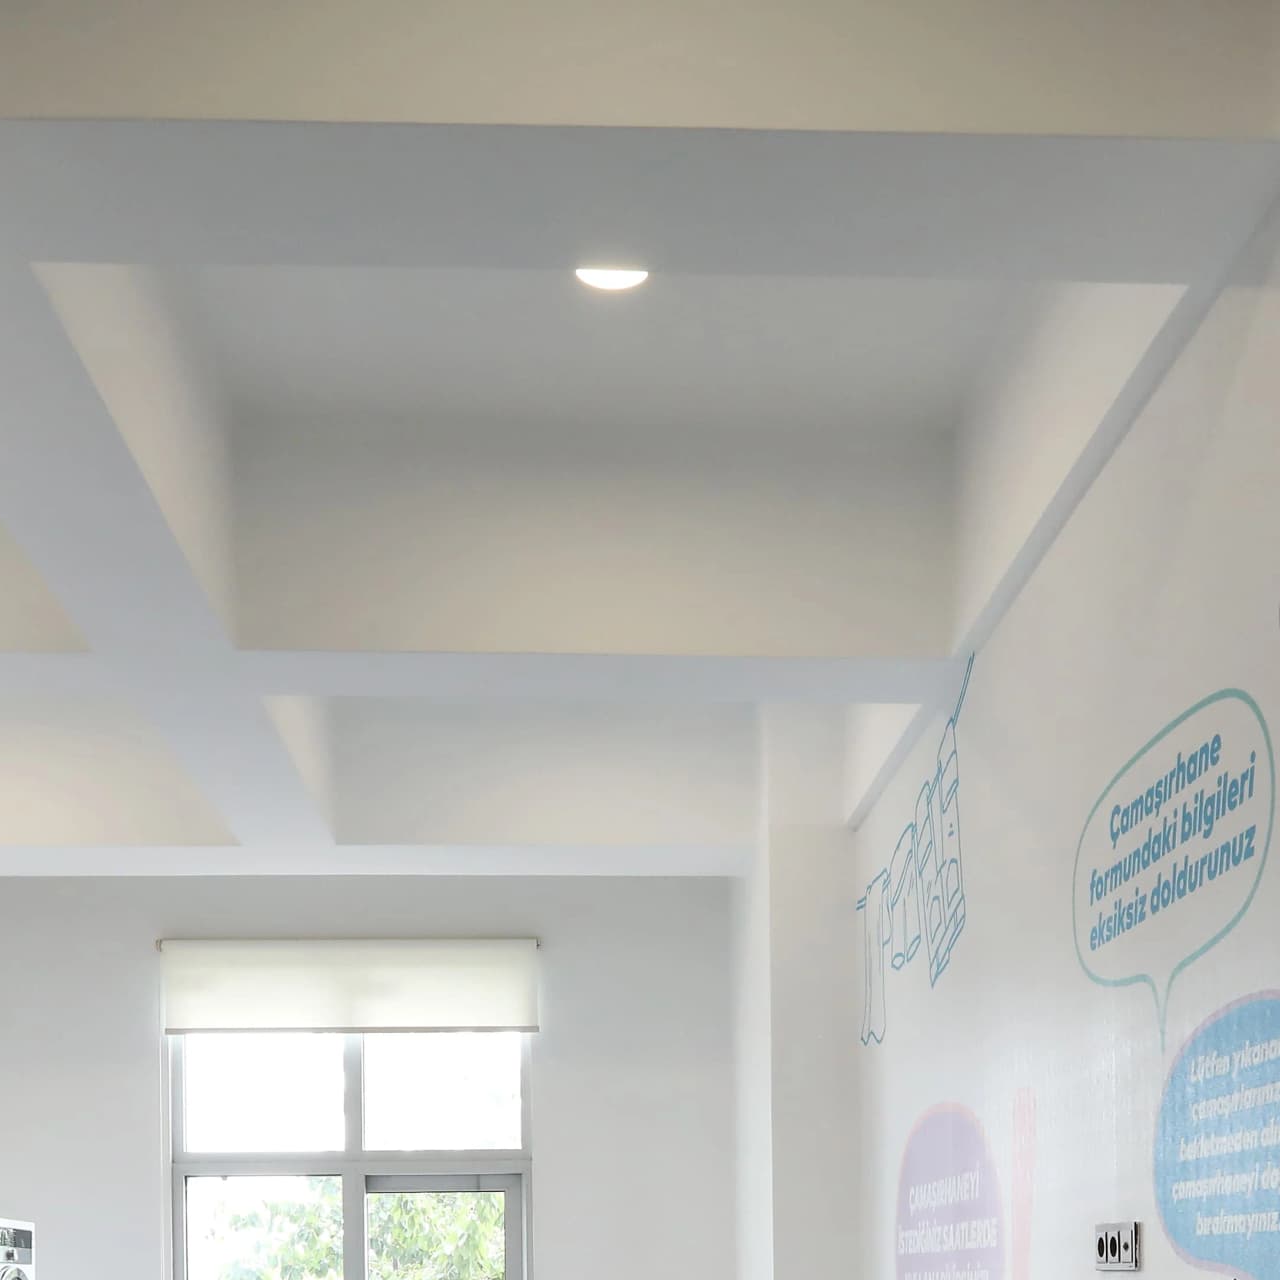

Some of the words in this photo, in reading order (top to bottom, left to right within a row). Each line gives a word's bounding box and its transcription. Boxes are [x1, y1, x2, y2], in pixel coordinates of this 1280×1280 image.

[1089, 806, 1178, 906] formundaki
[1180, 749, 1257, 844] bilgileri
[1109, 733, 1222, 850] Çamaşırhane
[1089, 886, 1148, 951] eksiksiz
[1150, 824, 1257, 915] doldurunuz
